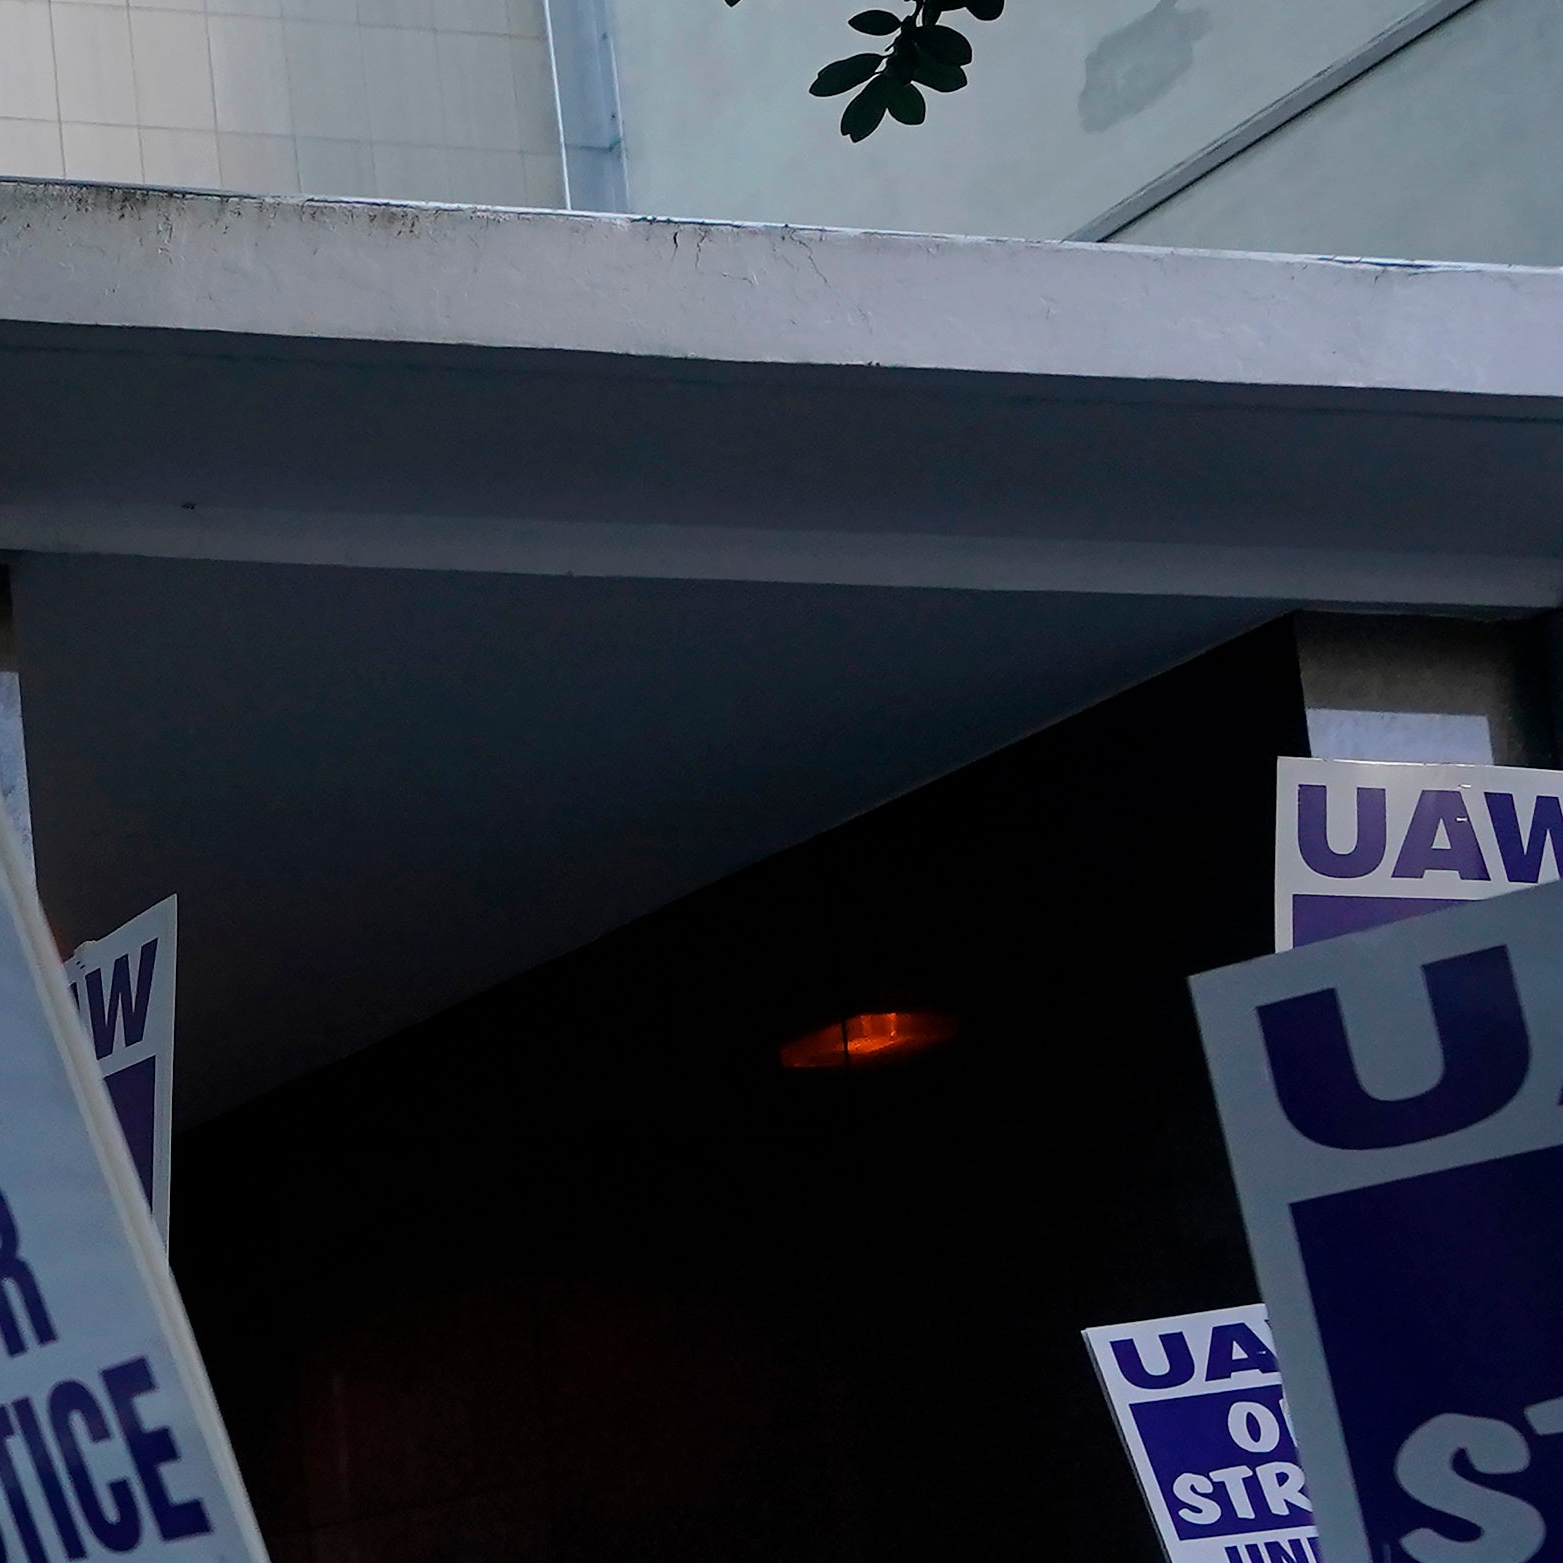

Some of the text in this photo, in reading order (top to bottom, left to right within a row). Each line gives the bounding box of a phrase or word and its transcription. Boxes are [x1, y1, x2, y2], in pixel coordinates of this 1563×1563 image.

[70, 937, 158, 1060] W
[1110, 1321, 1280, 1389] UA
[1226, 1398, 1299, 1454] O
